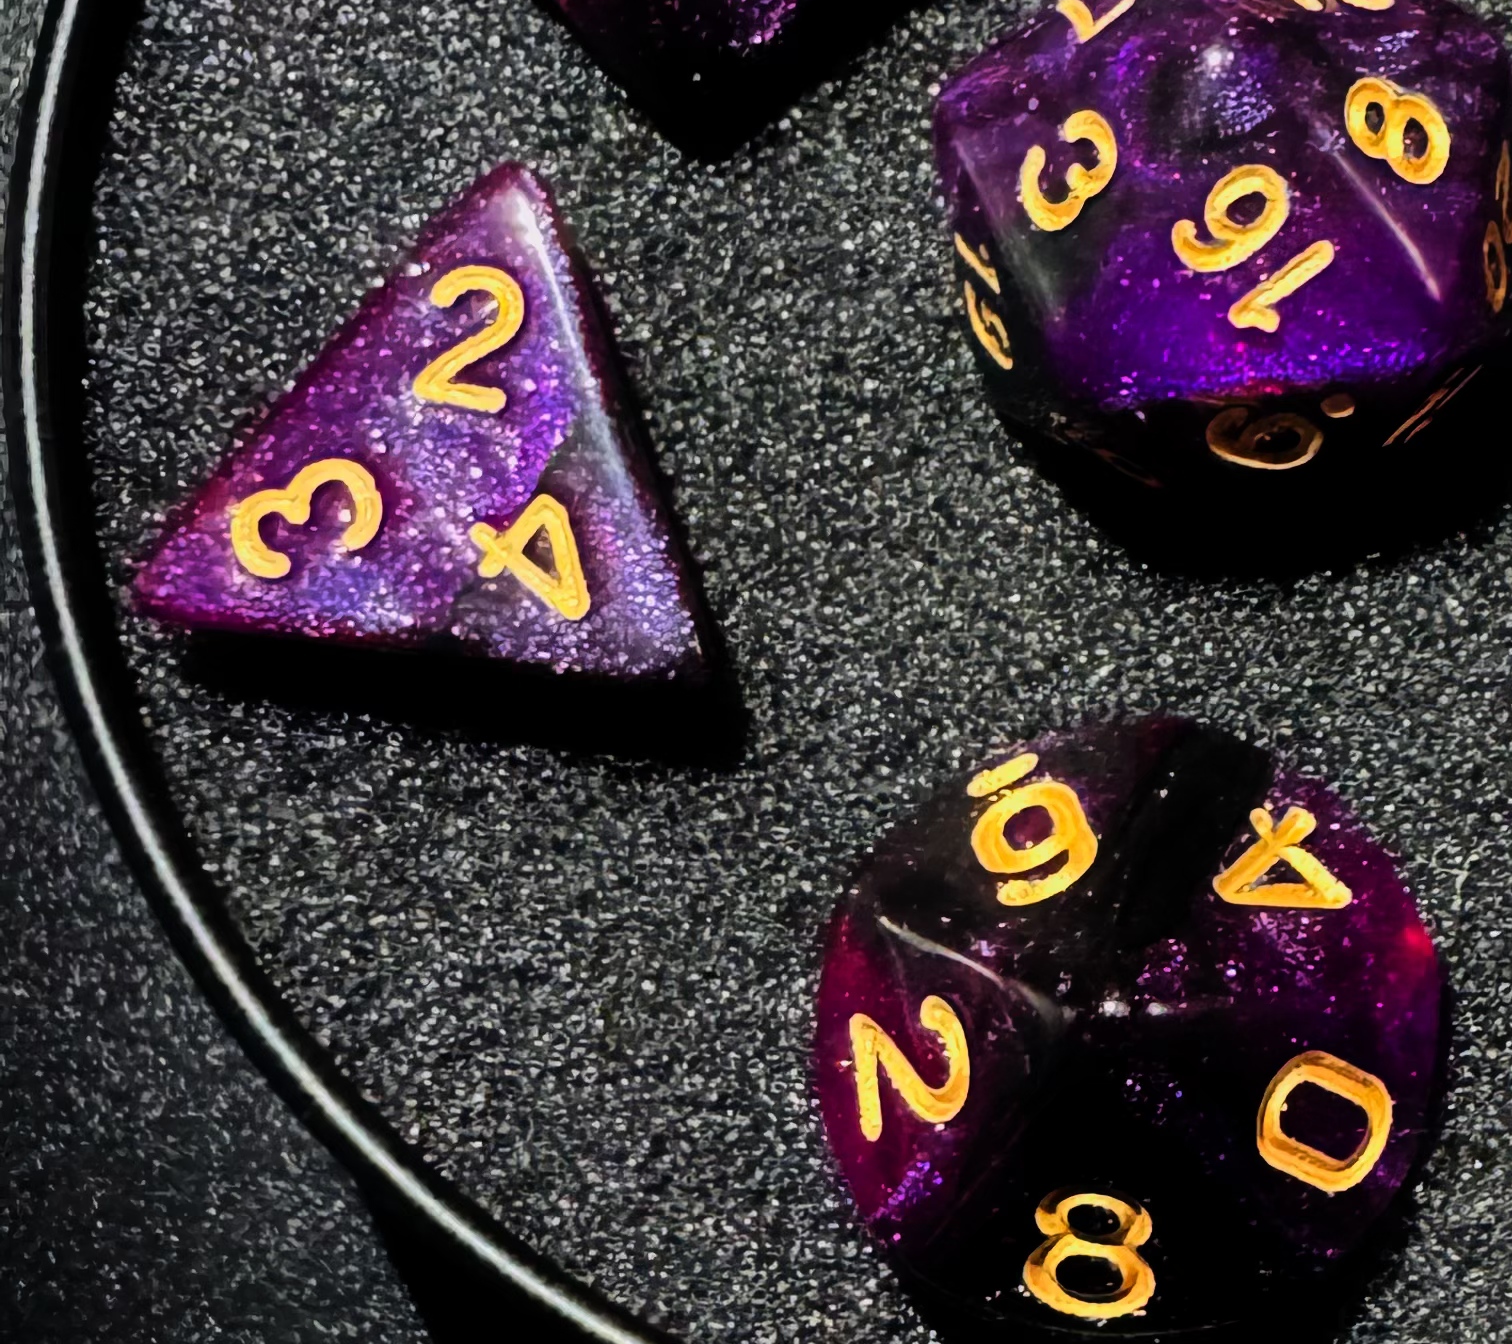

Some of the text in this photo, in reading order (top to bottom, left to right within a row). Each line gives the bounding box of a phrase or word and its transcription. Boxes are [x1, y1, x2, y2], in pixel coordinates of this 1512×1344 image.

[1020, 110, 1118, 231] 3
[1344, 77, 1451, 184] 8
[1171, 164, 1336, 333] 16
[413, 265, 525, 413] 2
[230, 458, 383, 578] 3
[470, 494, 591, 621] 4
[1213, 806, 1353, 909] 4
[849, 995, 971, 1142] 2
[1256, 1050, 1393, 1193] 0
[1022, 1189, 1157, 1318] 8
